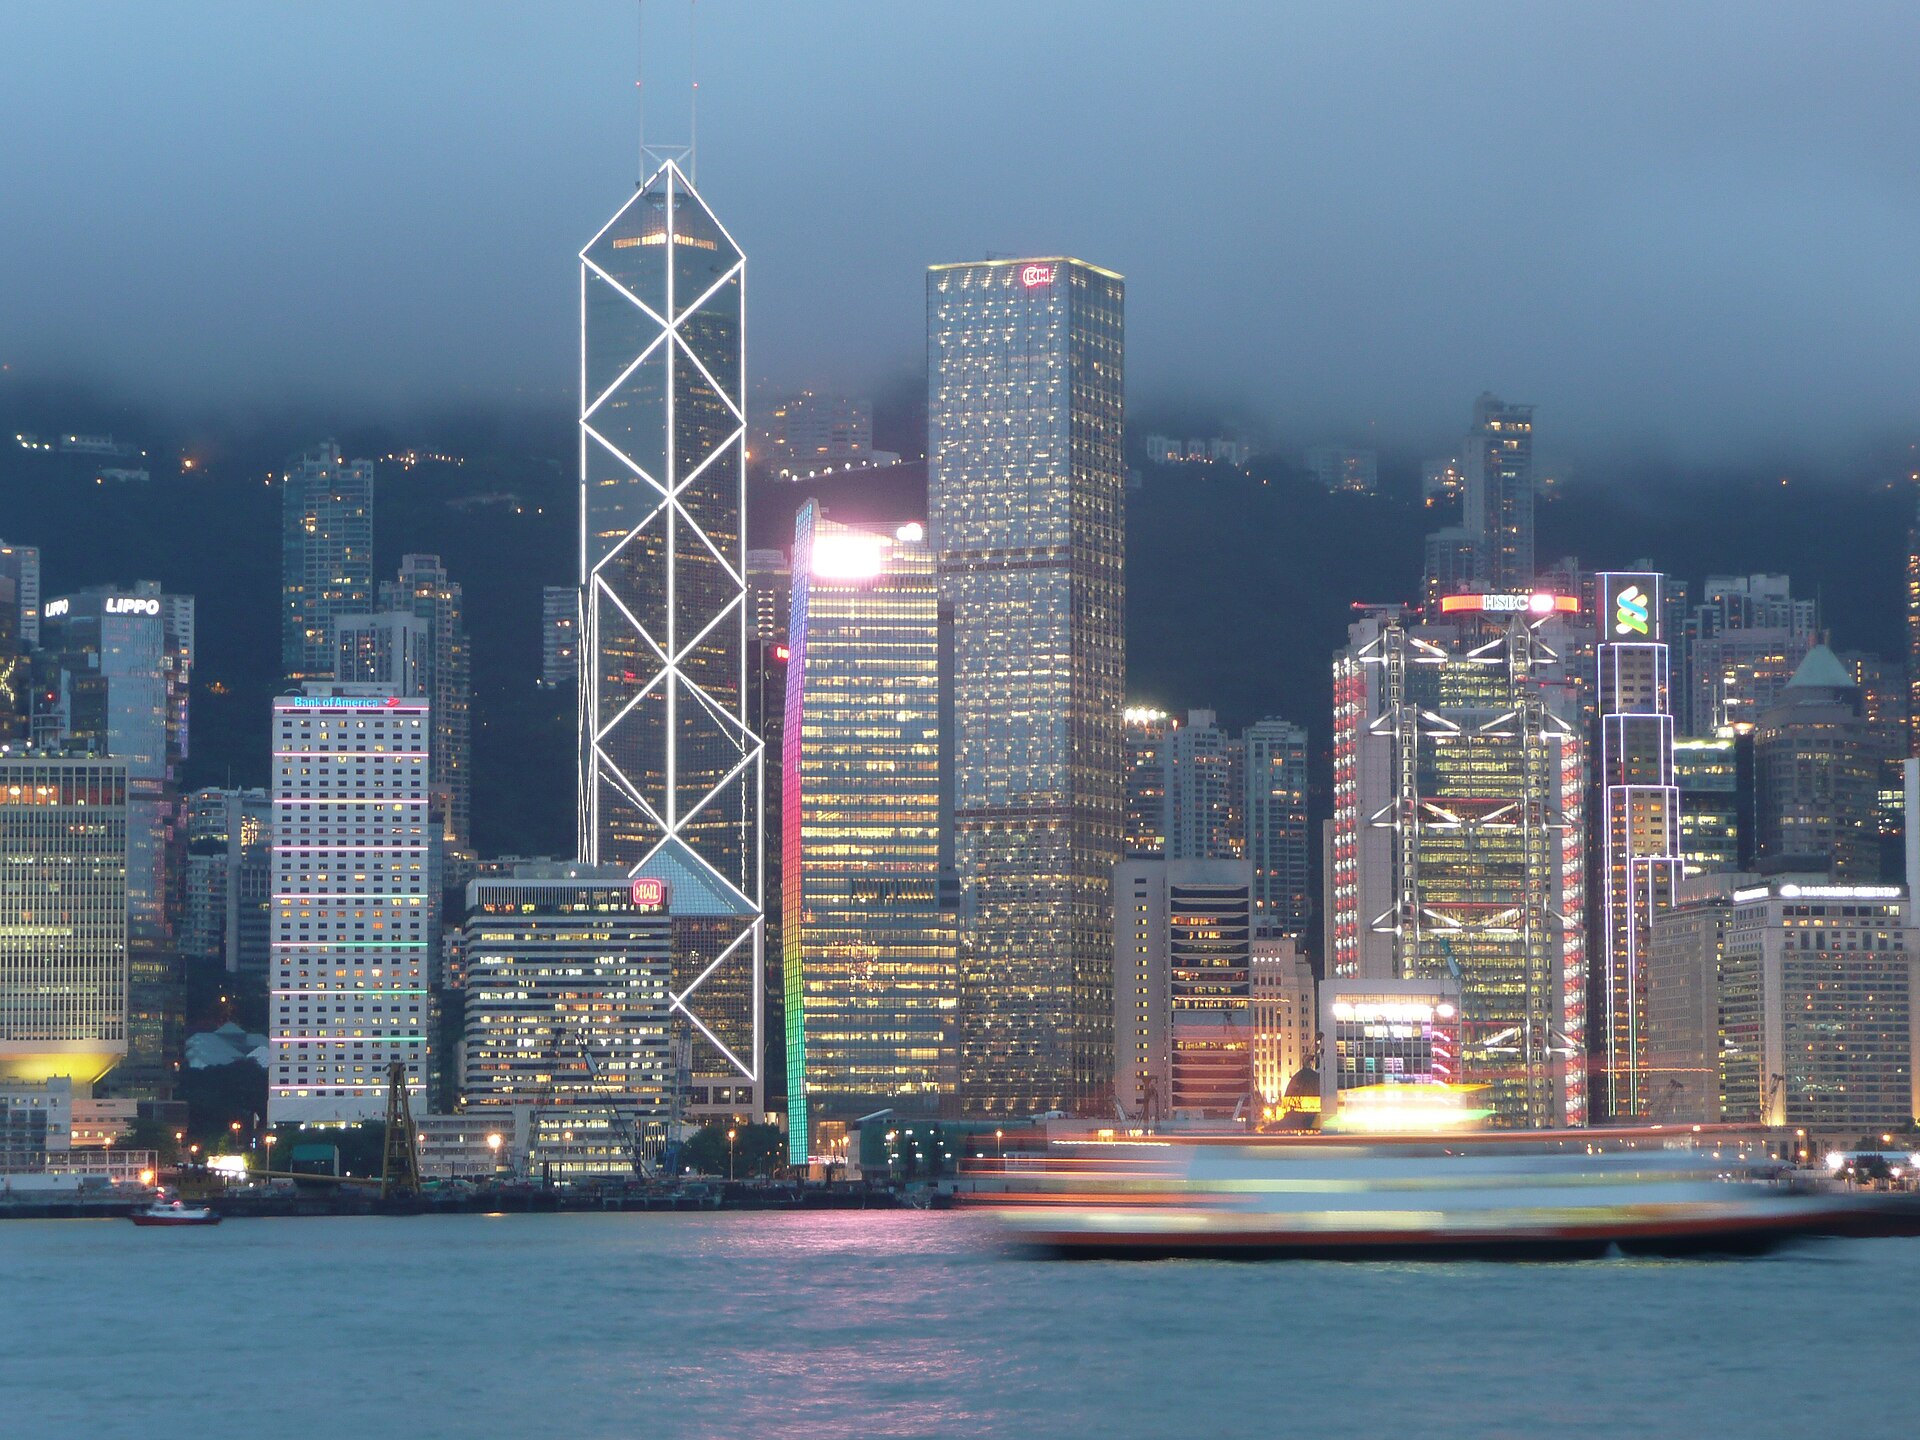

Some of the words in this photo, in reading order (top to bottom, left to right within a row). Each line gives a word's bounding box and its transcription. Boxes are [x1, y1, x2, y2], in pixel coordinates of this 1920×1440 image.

[45, 598, 69, 618] LIPPO
[105, 597, 160, 615] LIPPO
[1482, 595, 1530, 611] HSBC
[294, 696, 321, 707] Bank
[322, 696, 334, 707] of
[334, 696, 378, 707] America
